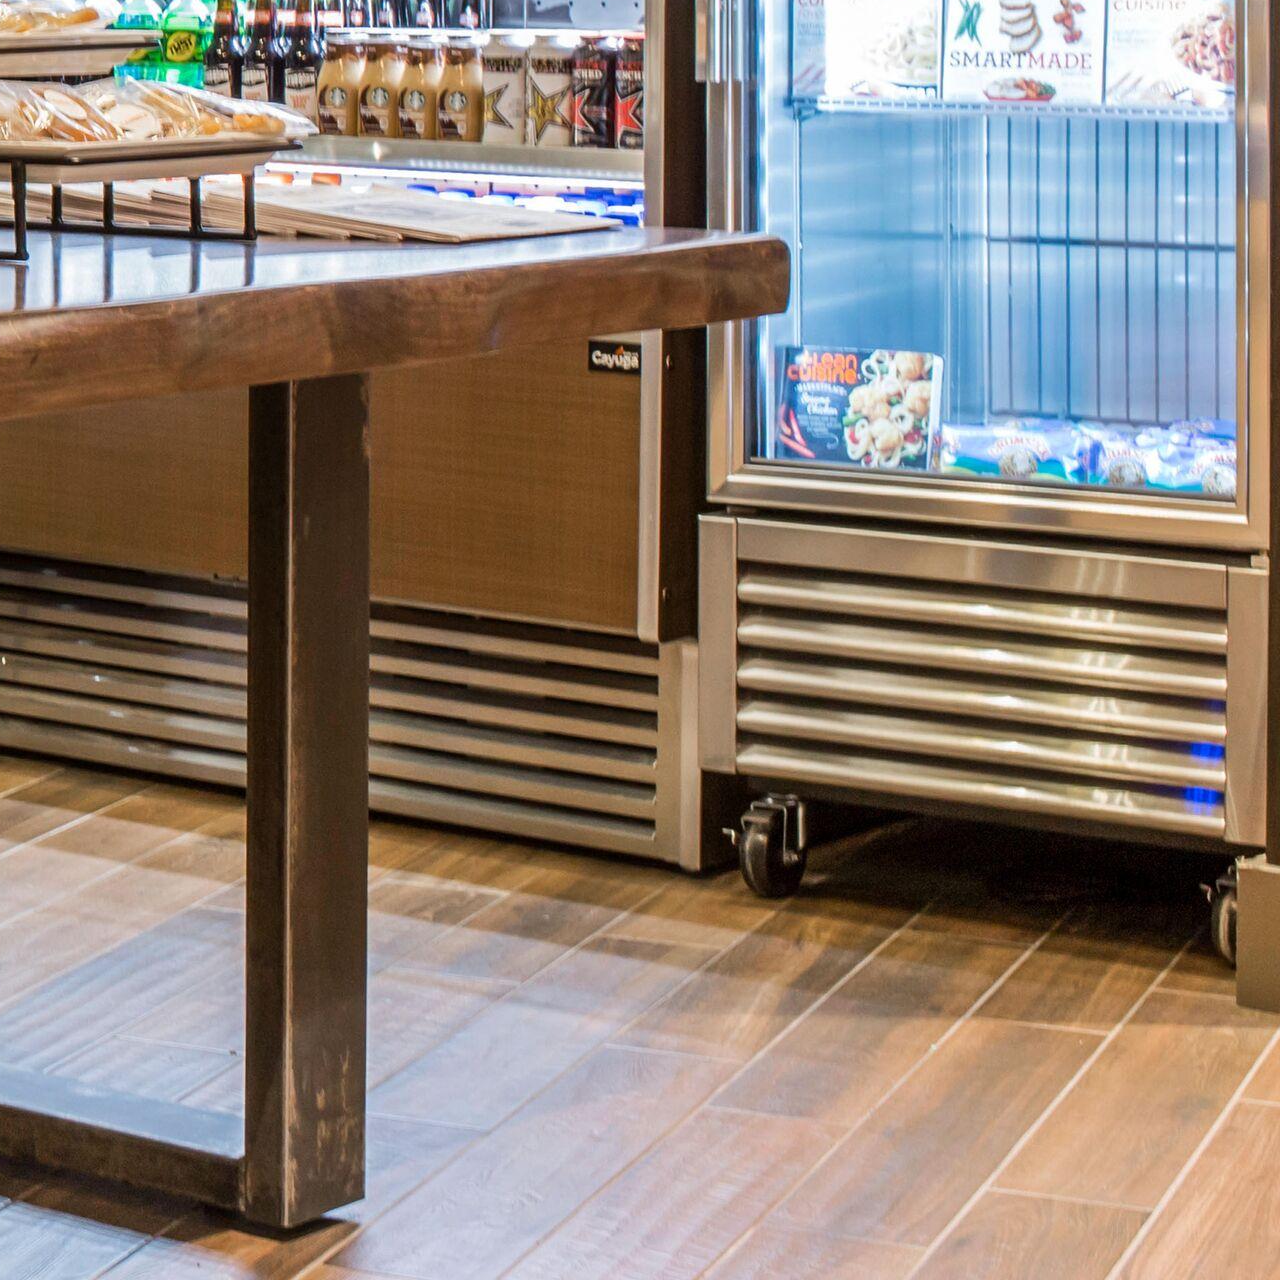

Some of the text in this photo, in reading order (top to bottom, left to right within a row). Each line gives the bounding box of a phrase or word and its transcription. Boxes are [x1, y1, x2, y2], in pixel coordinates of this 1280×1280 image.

[949, 50, 1093, 70] SMARTMADE
[592, 350, 639, 370] Cayuga
[787, 364, 858, 384] cuisine
